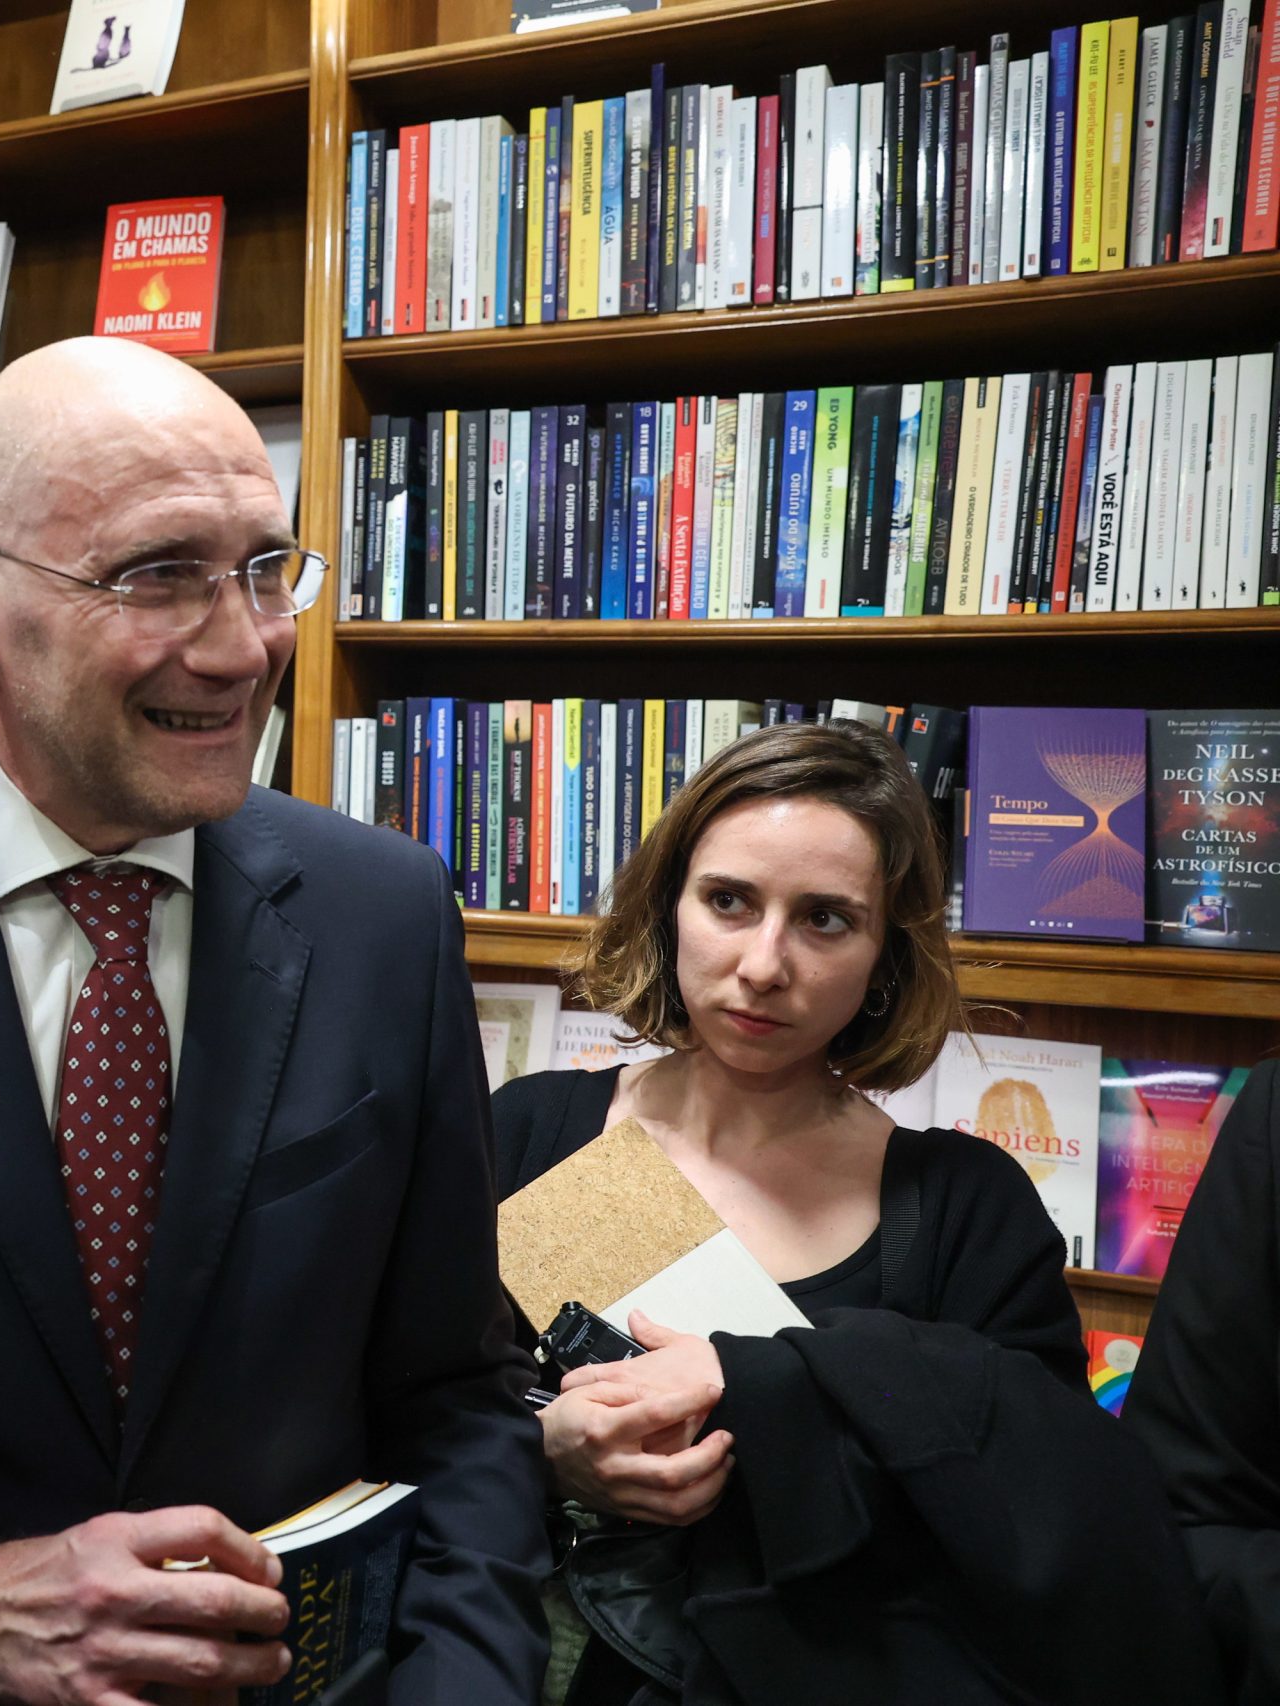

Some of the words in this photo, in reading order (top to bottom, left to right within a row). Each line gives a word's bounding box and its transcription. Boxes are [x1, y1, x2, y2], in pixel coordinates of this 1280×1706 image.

[1204, 21, 1213, 40] AMIT
[1222, 8, 1240, 59] Greenfield
[1234, 17, 1249, 45] Susan
[1148, 38, 1160, 68] JAMES
[1200, 41, 1211, 78] GOSWAMI
[1089, 66, 1098, 76] LEE
[1145, 70, 1158, 108] GLEICK
[1055, 118, 1065, 144] FUTURO
[1085, 92, 1098, 147] SUPERPOTÊNCIAS
[631, 129, 641, 149] FINS
[1054, 146, 1064, 156] DA
[631, 151, 641, 164] DO
[668, 146, 676, 174] BREVE
[1140, 138, 1154, 175] ISAAC
[582, 130, 594, 215] SUPERINTELIGÊNCIA
[630, 166, 641, 199] MUNDO
[1052, 158, 1066, 205] INTELIGÊNCIA
[1084, 160, 1096, 205] INTELIGÊNCIA
[666, 175, 676, 215] HISTÓRIA
[1134, 178, 1152, 237] NEWTON
[115, 219, 129, 241] O
[135, 212, 211, 239] MUNDO
[351, 207, 366, 240] DEUS
[604, 206, 615, 245] ÁGUA
[667, 216, 675, 230] DA
[1051, 207, 1062, 244] ARTIFICIAL
[113, 241, 136, 260] EM
[141, 236, 208, 257] CHAMAS
[665, 231, 676, 266] CIÊNCIA
[104, 314, 153, 334] NAOMI
[157, 311, 202, 330] KLEIN
[640, 407, 652, 418] 18
[793, 400, 808, 411] 29
[829, 398, 839, 413] ED
[1110, 383, 1122, 427] Christopher
[566, 415, 579, 426] 32
[640, 423, 649, 445] KAKU
[827, 416, 838, 451] YONG
[571, 439, 579, 466] MICHIO
[590, 434, 599, 449] 50
[790, 427, 798, 455] MICHIO
[798, 430, 806, 450] KAKU
[1108, 428, 1119, 451] Potter
[371, 439, 379, 479] HAWKING
[389, 436, 399, 485] HAWKING
[430, 456, 438, 486] Humphrey
[640, 447, 649, 474] MICHIO
[683, 452, 693, 489] Elizabeth
[826, 468, 834, 482] UM
[514, 491, 522, 502] AS
[587, 480, 600, 522] genética
[790, 473, 801, 516] FUTURO
[824, 486, 832, 520] MUNDO
[1102, 472, 1118, 510] VOCÊ
[513, 504, 522, 546] ORIGENS
[565, 493, 575, 530] FUTURO
[611, 509, 620, 543] MICHIO
[636, 501, 648, 546] PARALELOS
[678, 514, 688, 523] A
[964, 494, 976, 539] VERDADEIRO
[564, 532, 575, 546] DA
[673, 524, 688, 559] Sexta
[789, 519, 800, 535] DO
[821, 523, 831, 559] IMENSO
[911, 512, 927, 563] MATERIAIS
[935, 518, 948, 538] AVI
[1098, 513, 1115, 547] ESTÁ
[512, 550, 520, 562] DE
[694, 537, 707, 550] UM
[786, 537, 800, 570] FÍSICA
[962, 540, 974, 574] CRIADOR
[564, 547, 573, 578] MENTE
[610, 546, 619, 571] KAKU
[693, 552, 707, 569] CÉU
[931, 541, 947, 576] LOEB
[1094, 549, 1110, 586] AQUI
[511, 567, 520, 595] TUDO
[670, 560, 686, 612] Extinção
[692, 571, 706, 609] BRANCO
[962, 575, 972, 584] DE
[959, 585, 969, 606] TUDO
[437, 708, 445, 738] VACLAV
[437, 739, 445, 759] SMIL
[513, 750, 522, 765] KIP
[1196, 744, 1255, 760] NEIL
[381, 751, 394, 785] COSMOS
[585, 766, 594, 790] TUDO
[471, 770, 482, 820] INTELIGÊNCIA
[512, 767, 521, 802] THORNE
[1179, 790, 1265, 807] TYSON
[584, 802, 594, 820] QUE
[990, 795, 1048, 813] Tempo
[516, 822, 525, 851] CIÊNCIA
[585, 822, 596, 843] NÃO
[1182, 829, 1257, 843] CARTAS
[470, 823, 481, 872] ARTIFICIAL
[507, 817, 515, 884] INTERSTELLAR
[516, 852, 523, 865] DE
[584, 846, 594, 876] VEMOS
[1196, 846, 1215, 855] DE
[1218, 846, 1240, 856] UM
[1000, 1051, 1035, 1064] Noah
[1039, 1054, 1083, 1068] Harari
